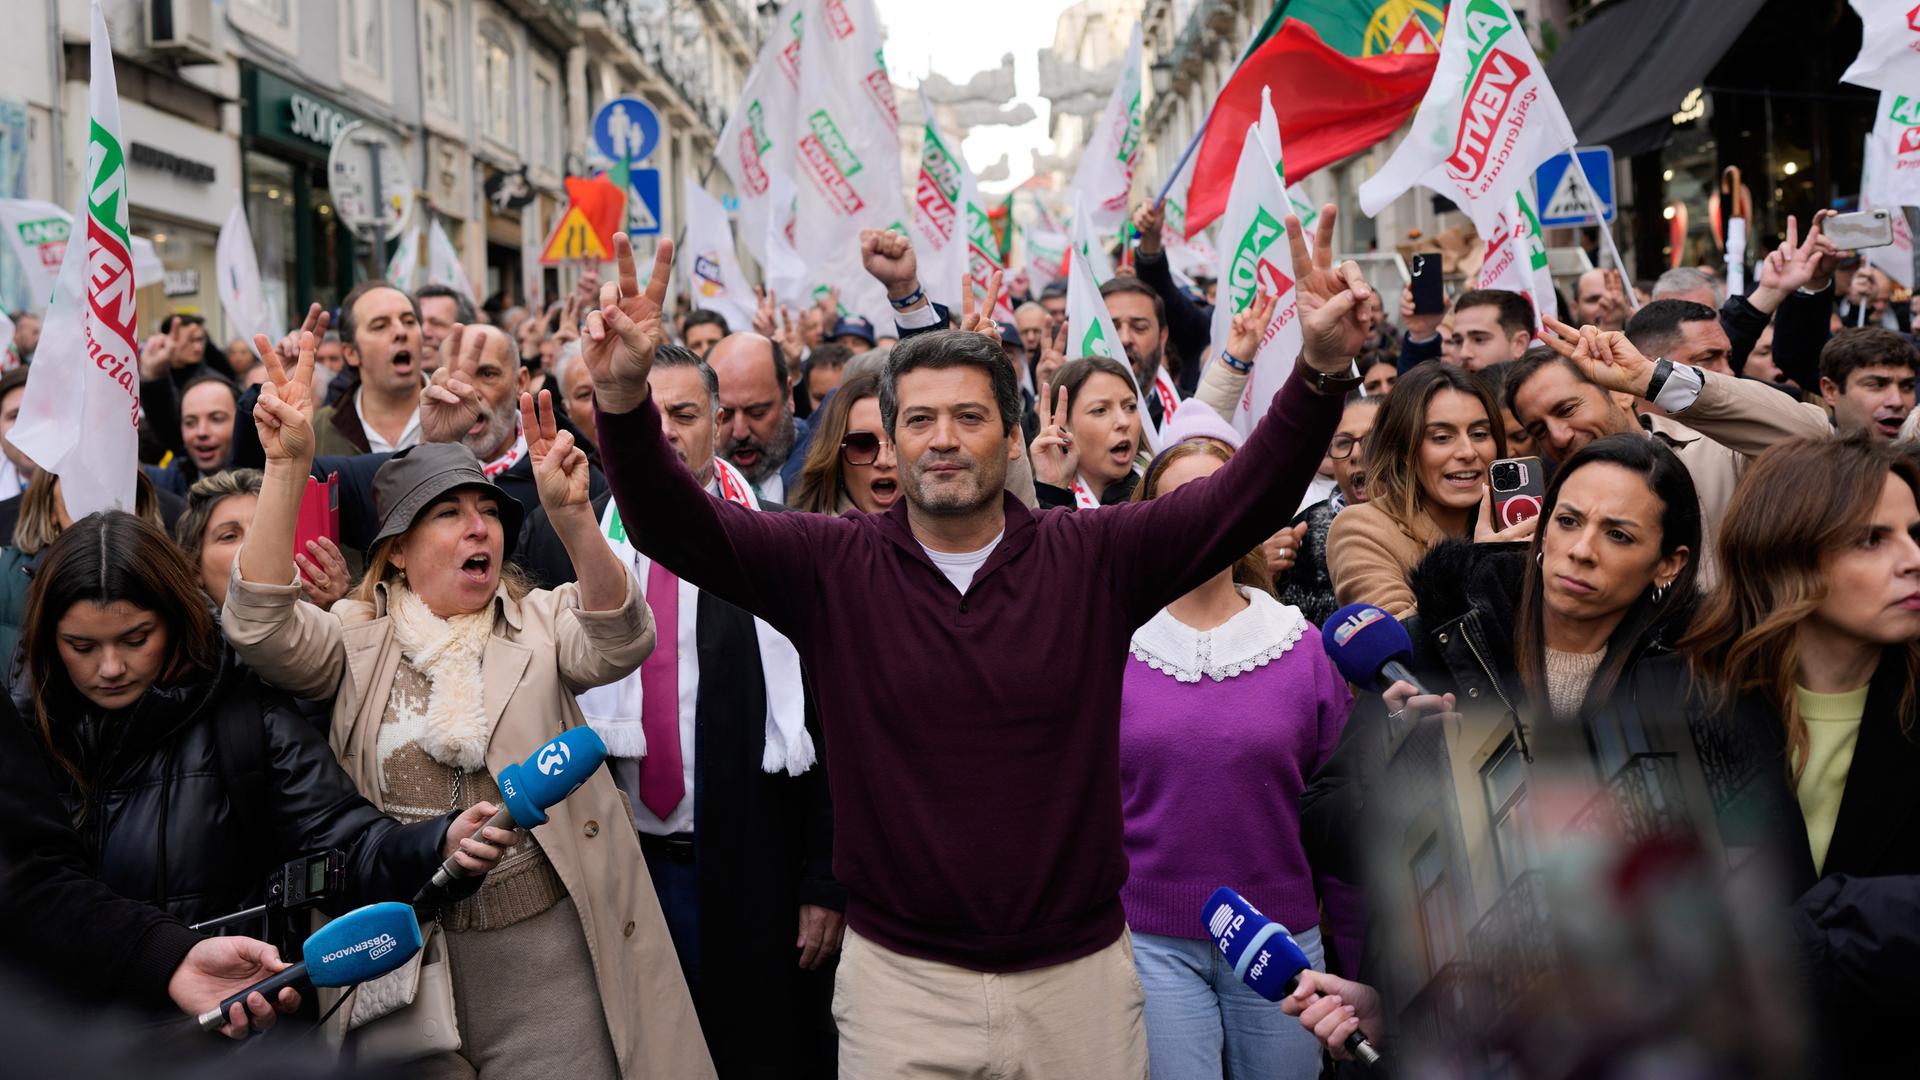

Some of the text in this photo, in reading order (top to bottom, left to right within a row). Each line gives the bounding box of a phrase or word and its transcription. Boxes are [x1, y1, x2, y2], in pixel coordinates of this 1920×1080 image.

[503, 778, 517, 799] rr.pt
[321, 933, 392, 963] OBSERVADOR
[1219, 914, 1245, 954] RTP
[1250, 949, 1272, 981] rtp.pt
